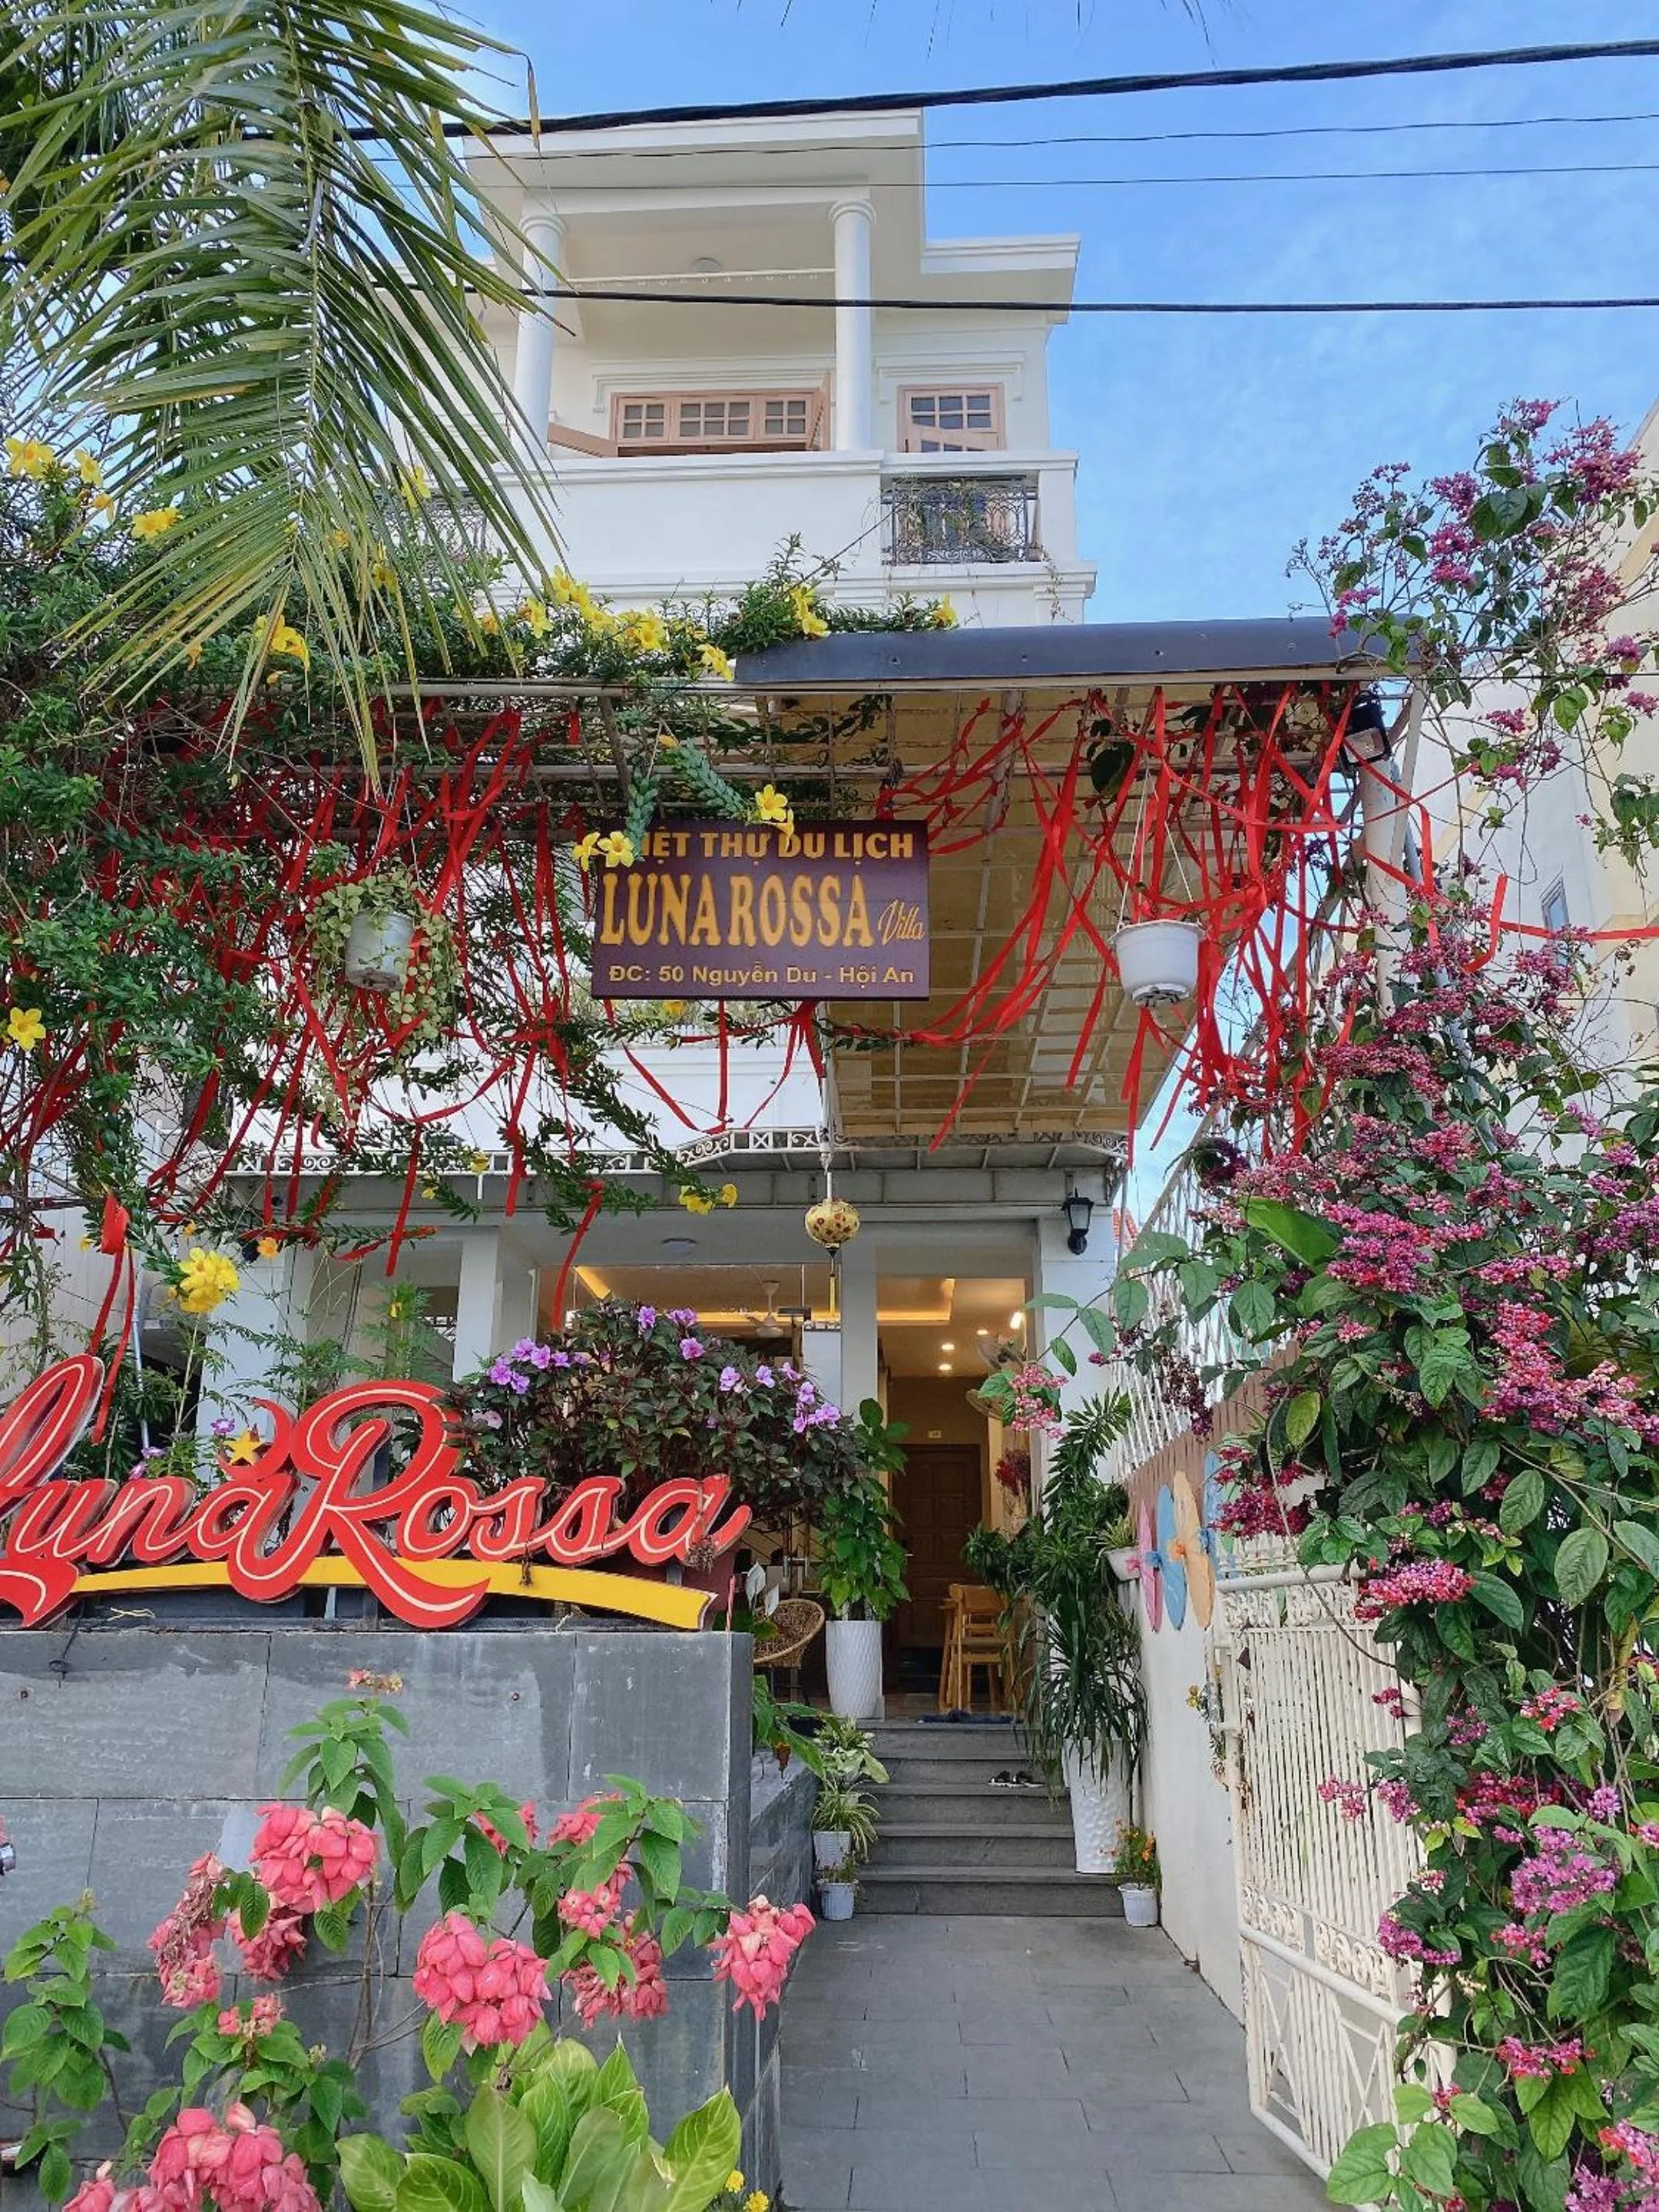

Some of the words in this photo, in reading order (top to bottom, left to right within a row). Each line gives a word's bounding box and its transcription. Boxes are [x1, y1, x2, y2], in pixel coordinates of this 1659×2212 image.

[628, 826, 691, 865] IỆT
[778, 833, 825, 858] DU
[834, 833, 913, 866] LỊCH
[600, 873, 721, 947] LUNA
[728, 873, 874, 948] ROSSA
[878, 899, 925, 945] Villa
[608, 965, 651, 982] ĐC:
[658, 965, 684, 982] 50
[692, 961, 778, 986] Nguyễn
[786, 967, 816, 983] Du
[839, 965, 876, 989] Hội
[882, 967, 914, 983] An
[288, 1380, 753, 1629] Rossa
